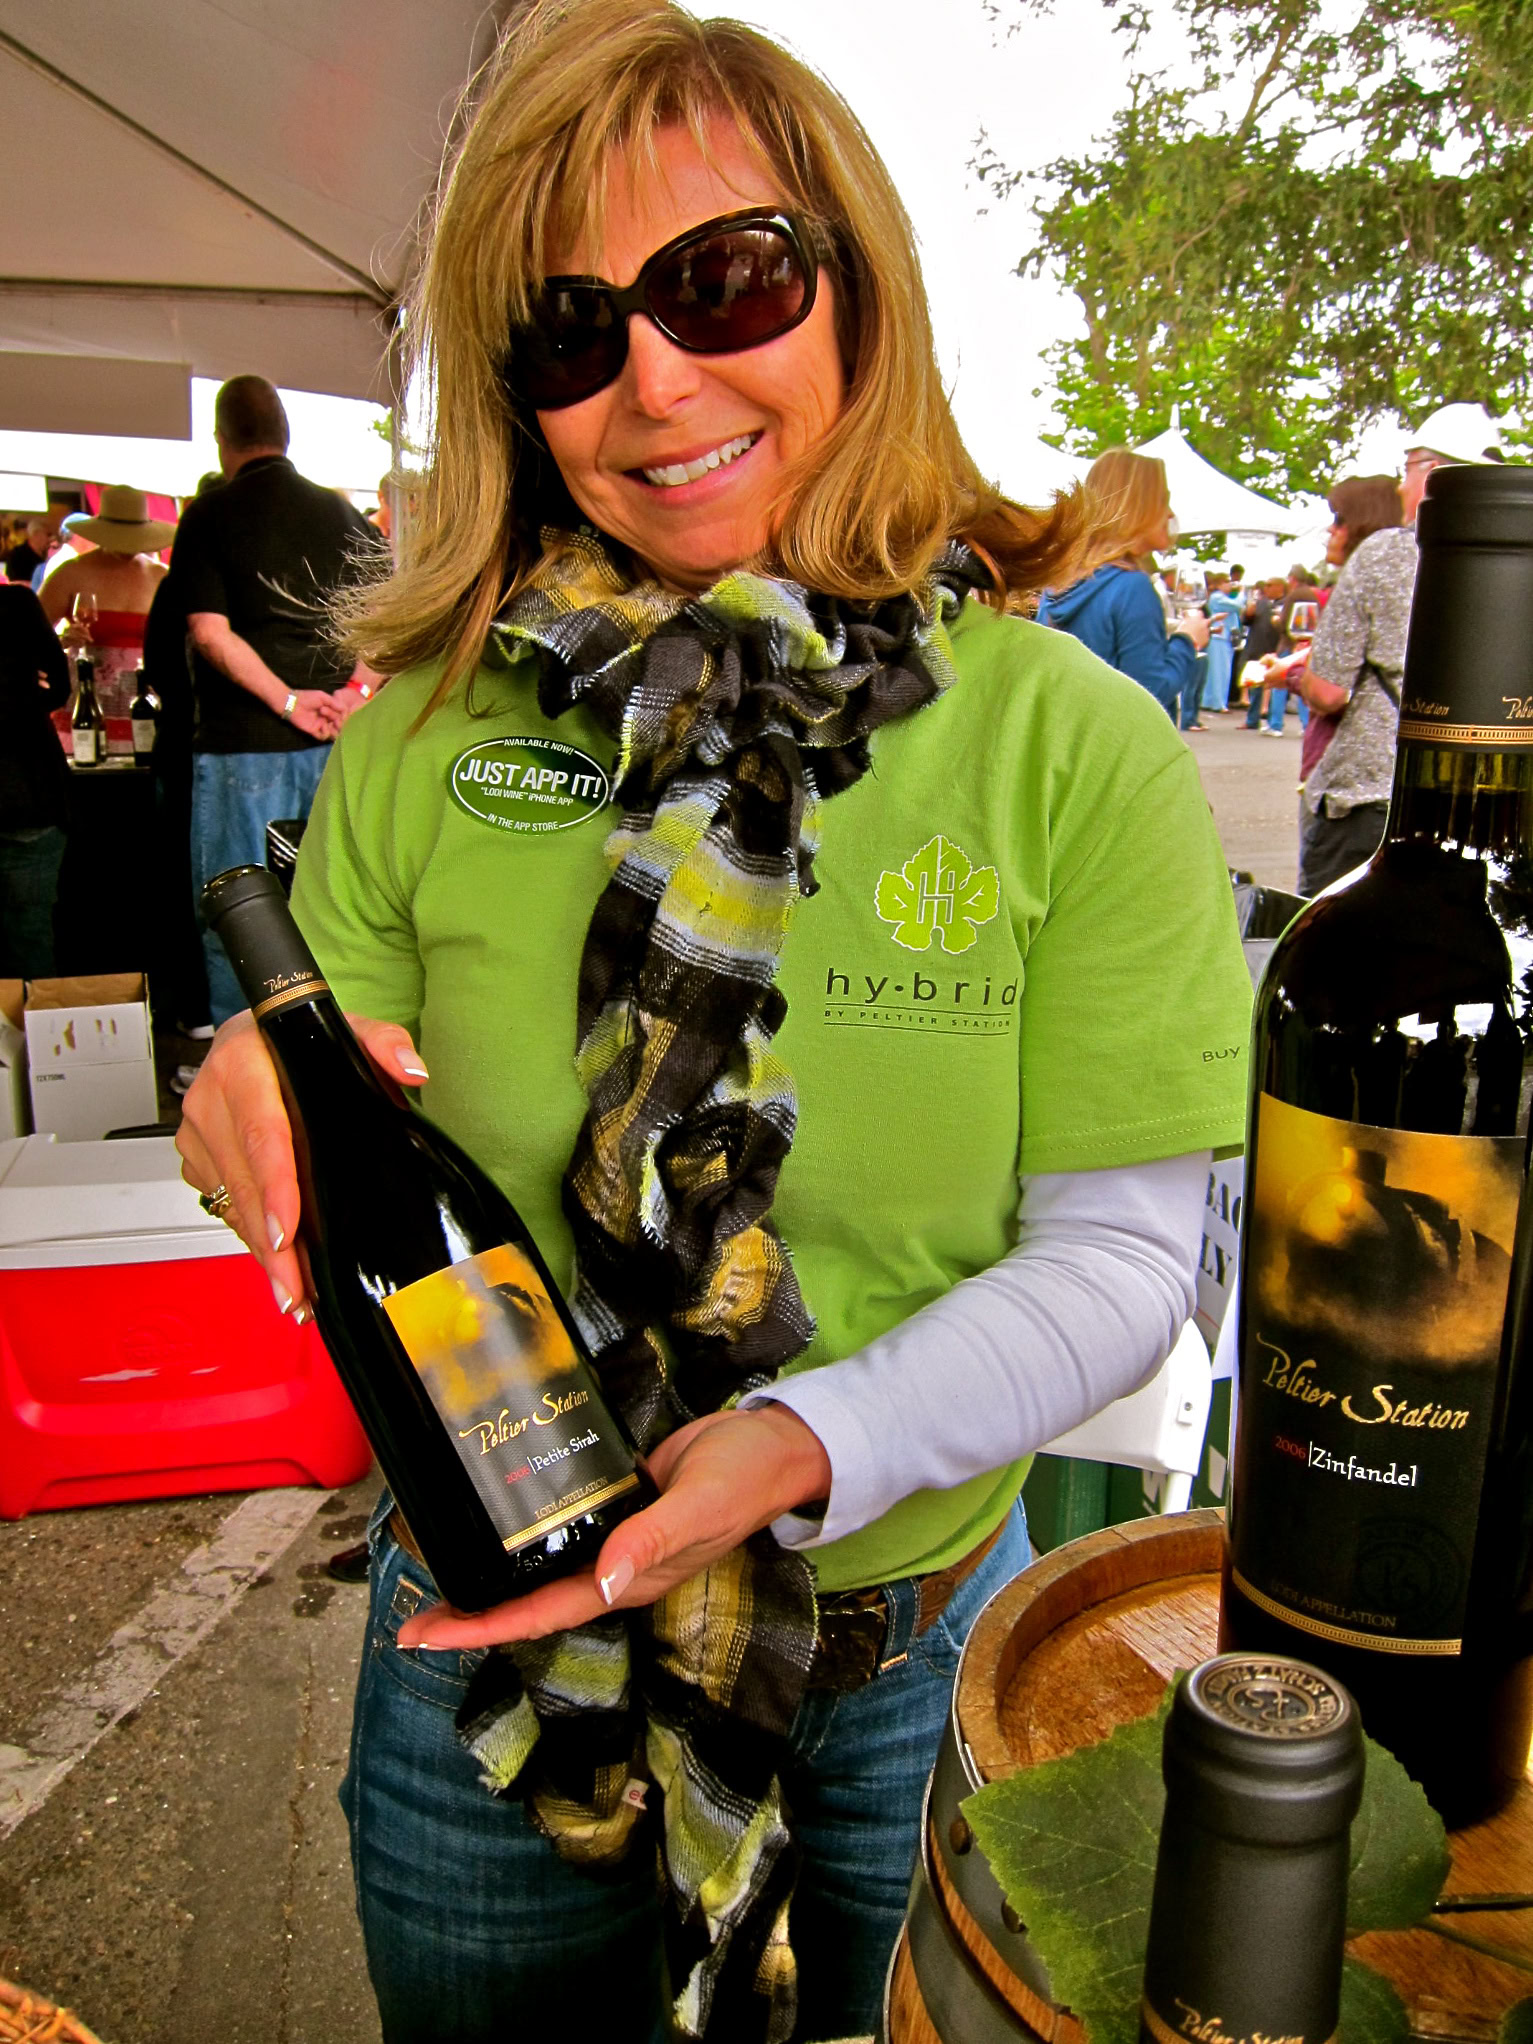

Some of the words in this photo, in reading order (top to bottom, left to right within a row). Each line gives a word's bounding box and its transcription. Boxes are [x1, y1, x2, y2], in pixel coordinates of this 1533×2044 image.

[1502, 696, 1533, 719] Pelti
[503, 738, 549, 750] AVAILABLE
[551, 742, 574, 756] NOW!
[459, 758, 521, 786] JUST
[519, 766, 569, 793] APP
[570, 773, 602, 799] IT!
[528, 792, 557, 806] iPHONE
[557, 797, 574, 807] APP
[486, 812, 498, 825] IN
[498, 816, 514, 830] THE
[514, 820, 531, 832] APP
[531, 820, 560, 832] STORE
[824, 1009, 845, 1018] BY
[859, 1011, 938, 1025] PELTIER
[951, 1018, 1011, 1029] STATION
[1201, 1046, 1242, 1063] BUY
[1256, 1332, 1337, 1408] Peltier
[1341, 1383, 1470, 1431] Station
[458, 1408, 530, 1456] Peltier
[531, 1390, 589, 1427] Station
[531, 1446, 572, 1472] Petite
[569, 1428, 601, 1453] Sirah
[1274, 1434, 1307, 1461] 2006
[1311, 1446, 1418, 1487] Zinfandel
[534, 1500, 560, 1521] LODI
[558, 1475, 609, 1509] APPELLATION
[1300, 1594, 1398, 1629] APPELLATION
